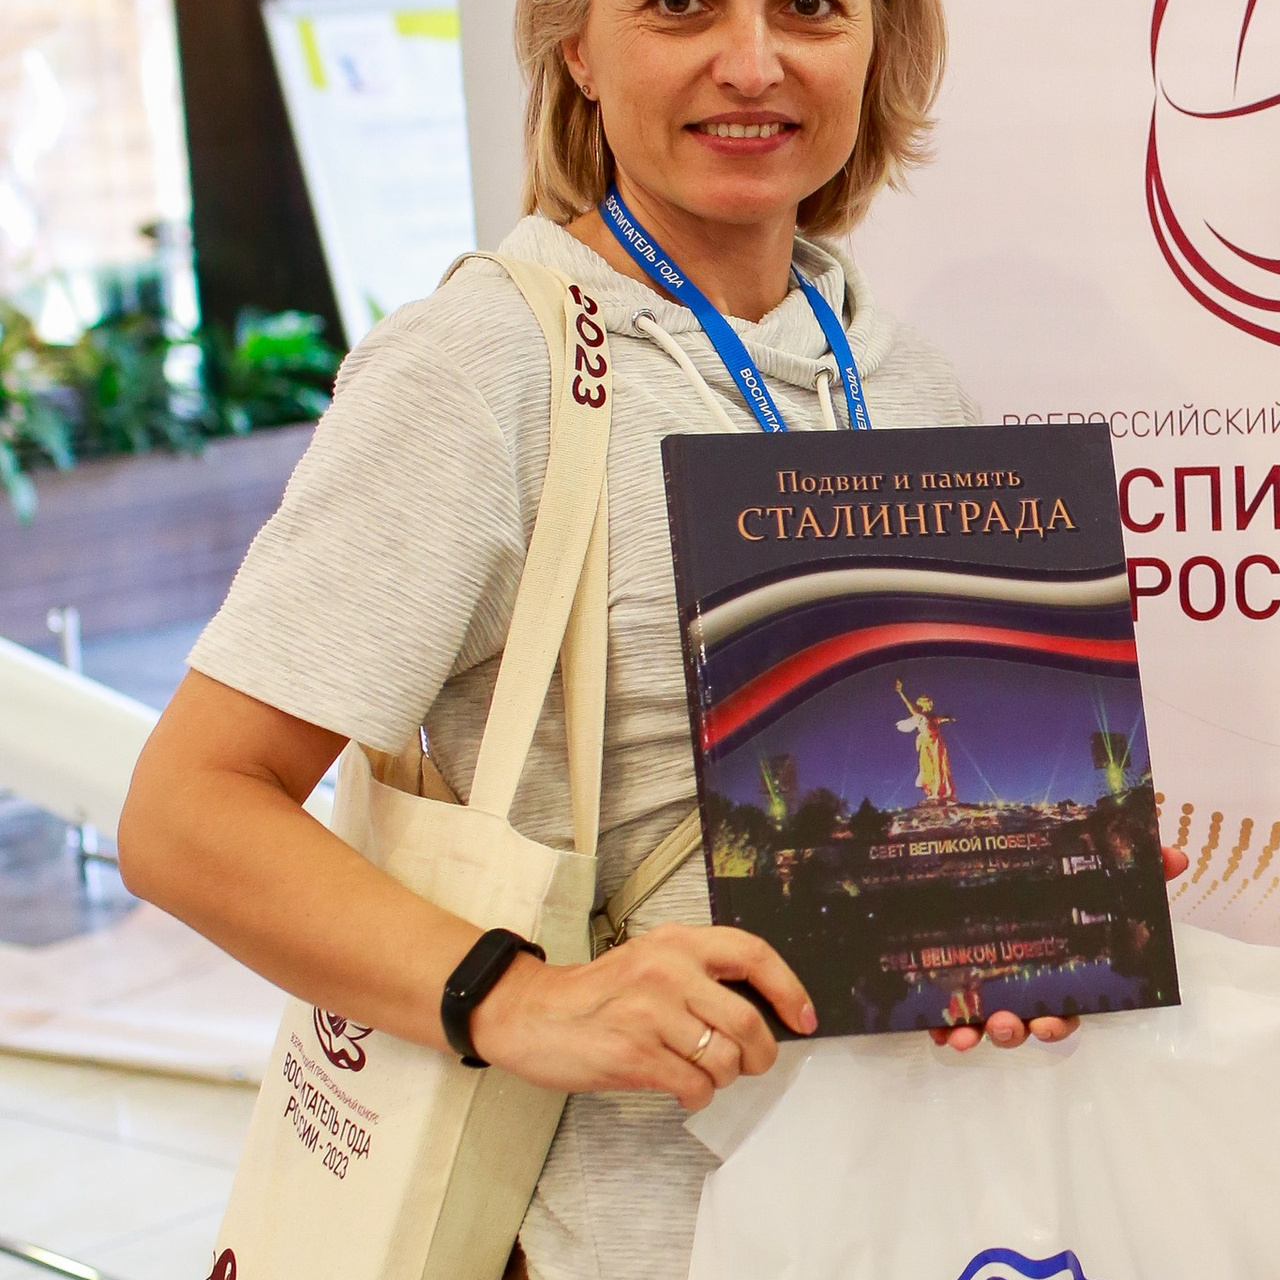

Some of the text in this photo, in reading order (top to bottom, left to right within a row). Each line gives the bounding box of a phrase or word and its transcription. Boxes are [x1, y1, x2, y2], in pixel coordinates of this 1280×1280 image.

[605, 194, 685, 289] ВОСПИТАТЕЛЬ ГОДА
[568, 284, 607, 409] 2023
[846, 367, 861, 401] ГОДА
[776, 469, 1022, 497] Подвиг и память
[737, 497, 1077, 540] СТАЛИНГРАДА
[909, 836, 981, 856] ВЕЛИКОЙ
[340, 1117, 372, 1159] ГОДА
[322, 1141, 349, 1180] 2023
